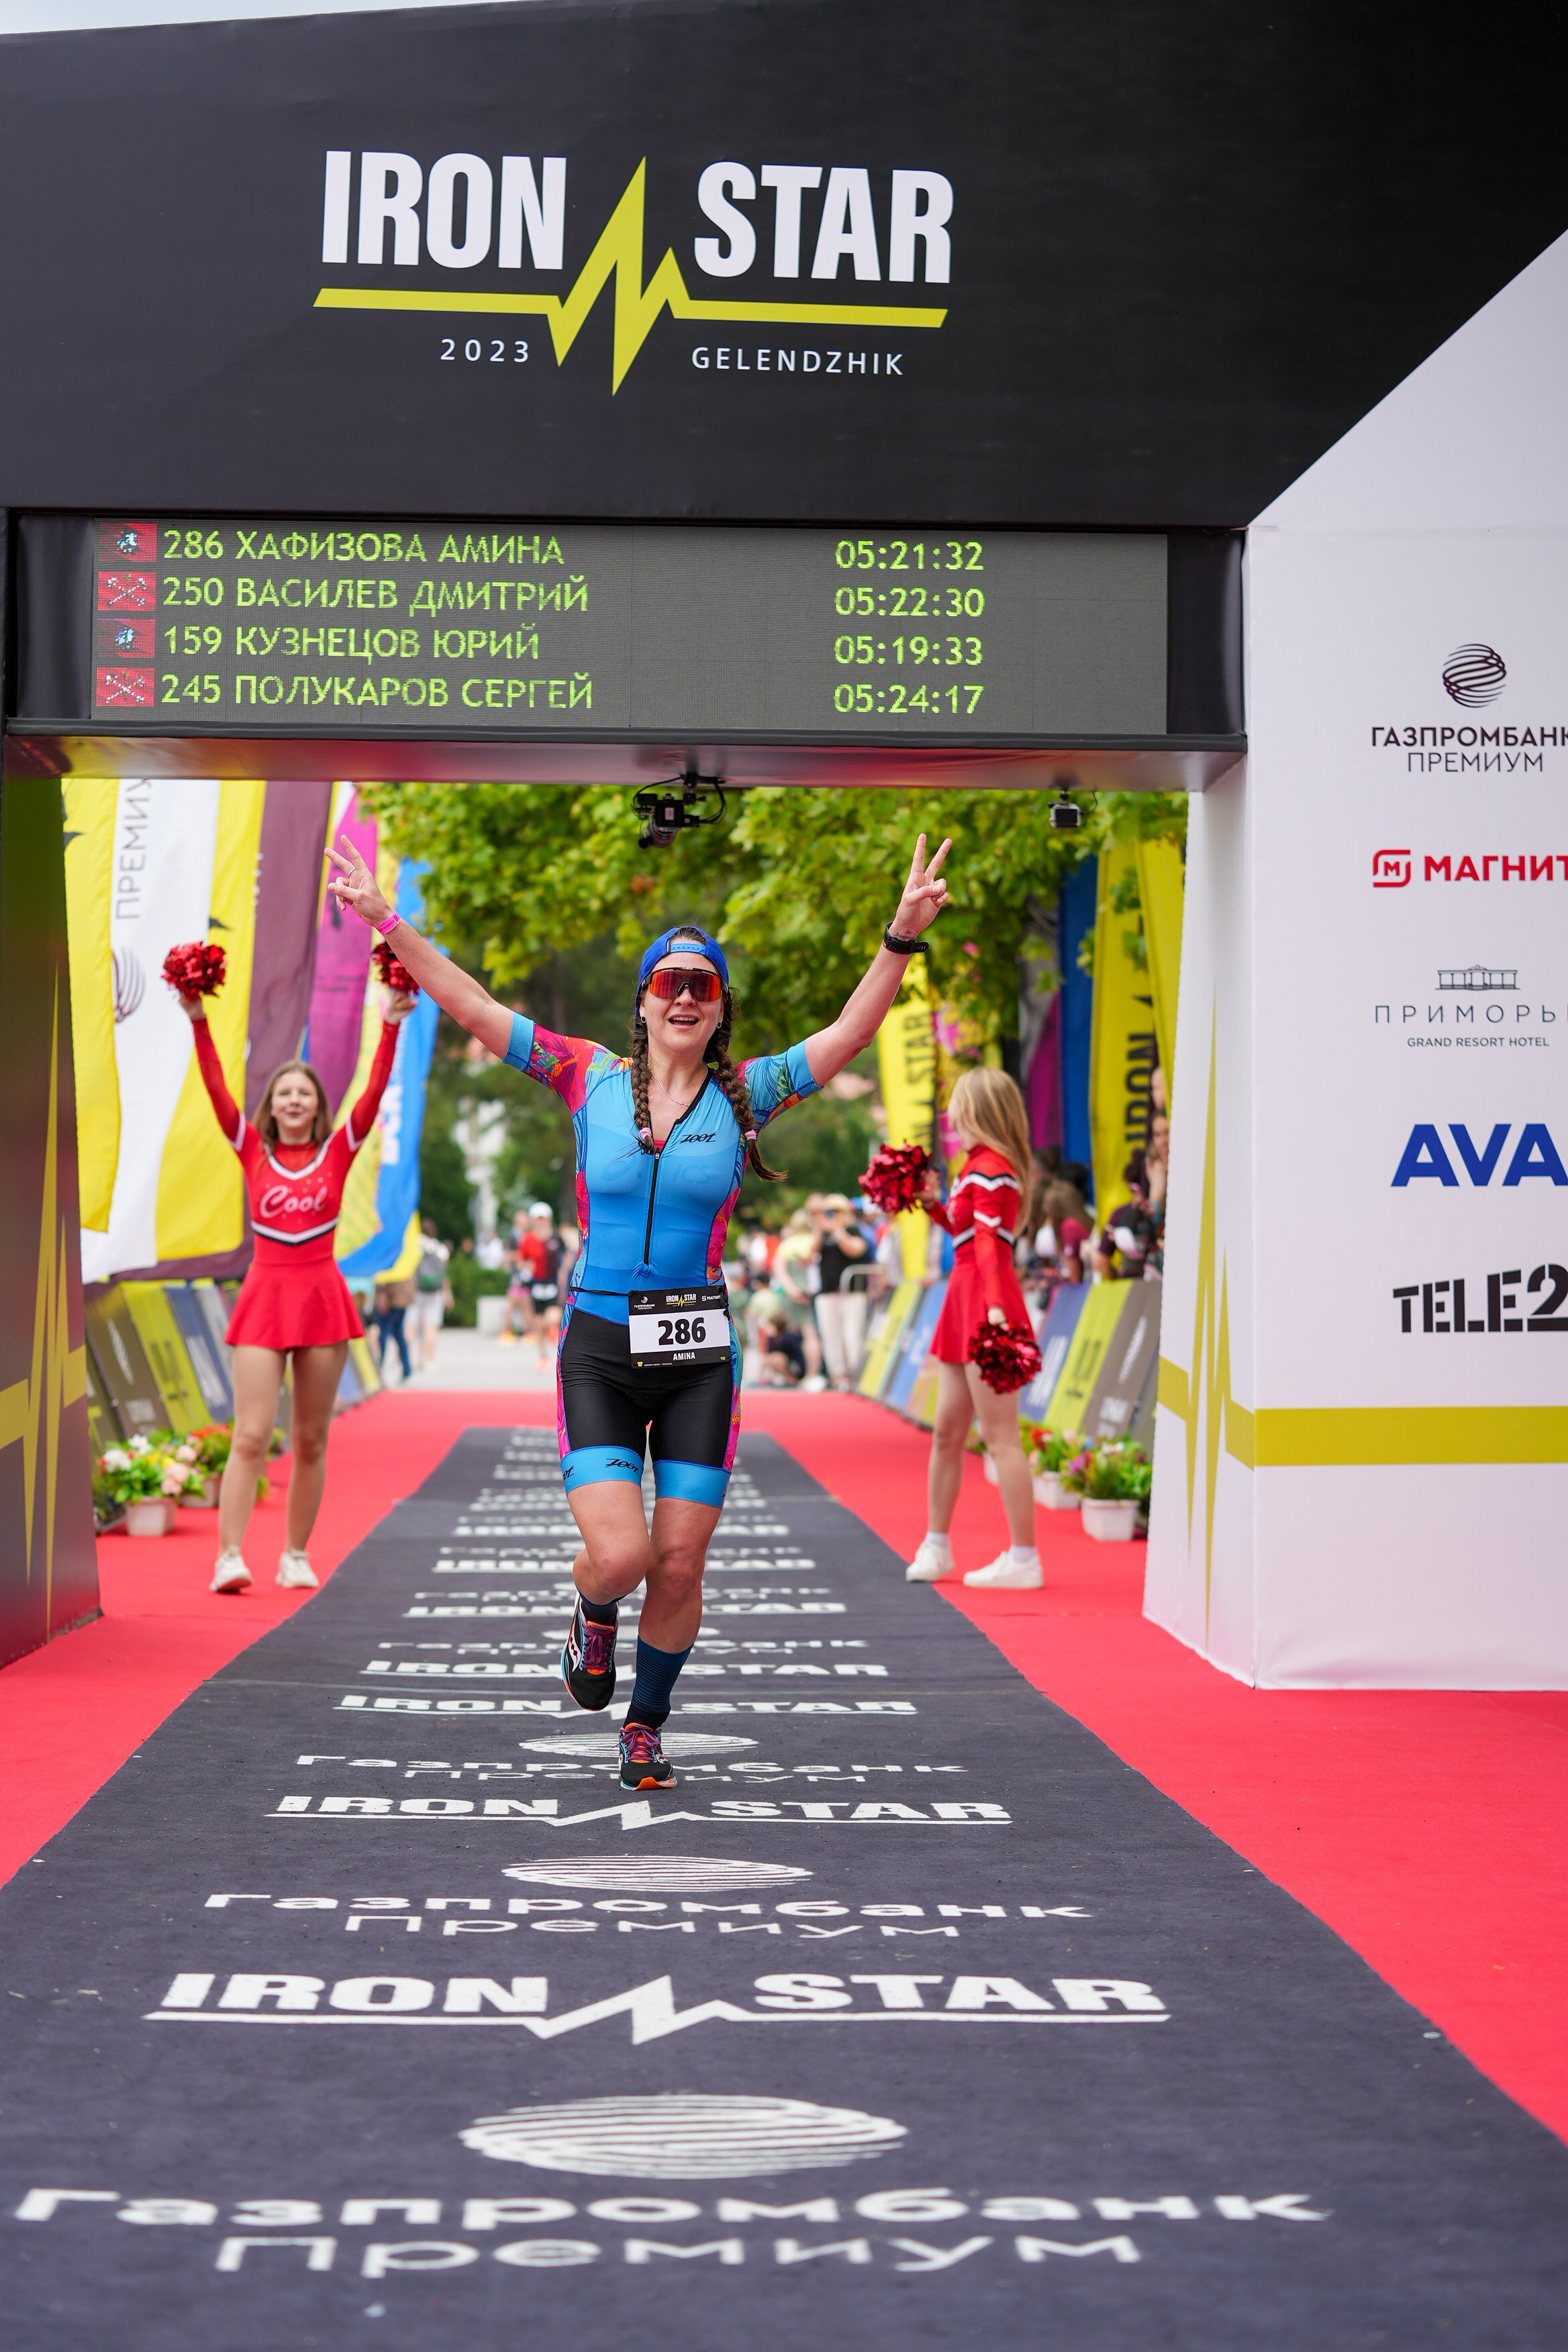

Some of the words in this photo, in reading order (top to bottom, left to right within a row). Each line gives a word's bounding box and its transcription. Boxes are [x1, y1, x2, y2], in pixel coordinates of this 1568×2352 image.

[322, 150, 567, 270] IRON
[694, 161, 954, 284] STAR
[440, 338, 529, 362] 2023
[692, 346, 903, 376] GELENDZHIK
[164, 529, 224, 558] 286
[236, 530, 427, 562] ХАФИЗОВА
[438, 534, 565, 565] АМИНА
[835, 540, 984, 570] 05:21:32
[163, 576, 224, 605] 250
[236, 577, 398, 609] ВАСИЛЕВ
[409, 575, 589, 617] ДМИТРИЙ
[834, 586, 985, 617] 05:22:30
[164, 625, 222, 655] 159
[236, 626, 421, 665] КУЗНЕЦОВ
[433, 624, 539, 660] ЮРИЙ
[834, 634, 983, 665] 05:19:33
[162, 673, 222, 703] 245
[235, 674, 449, 707] ПОЛУКАРОВ
[462, 672, 593, 709] СЕРГЕЙ
[834, 683, 985, 714] 05:24:17
[1408, 752, 1543, 773] ПРЕМИУМ
[1424, 854, 1568, 881] МАГНИТ
[1375, 1004, 1568, 1024] ПРИМОРЬ
[1407, 1037, 1452, 1047] GRAND
[1456, 1037, 1505, 1047] RESORT
[1509, 1037, 1550, 1047] HOTEL
[1390, 1123, 1568, 1187] AVA
[260, 1185, 328, 1219] Cool
[666, 1295, 679, 1303] IRON
[684, 1293, 697, 1302] STAR
[1393, 1263, 1568, 1333] TELE2
[658, 1317, 706, 1346] 286
[673, 1352, 695, 1361] AMINA
[366, 1660, 563, 1674] IRON
[679, 1664, 889, 1675] STAR
[340, 1694, 561, 1711] IRON
[680, 1701, 918, 1712] STAR
[276, 1796, 558, 1816] IRON
[709, 1800, 1013, 1820] STAR
[161, 1973, 548, 2012] IRON
[753, 1973, 1167, 2011] STAR
